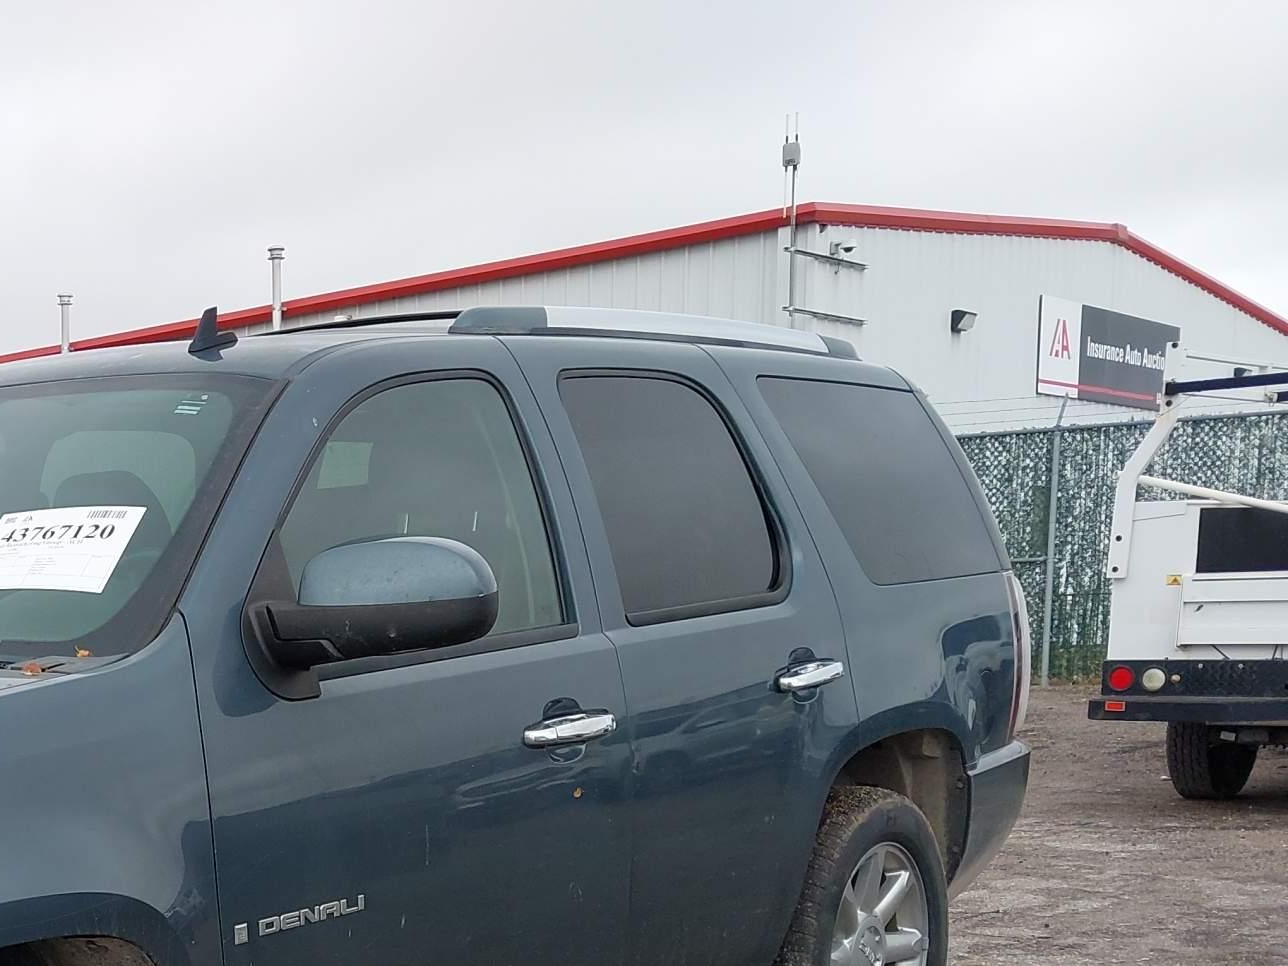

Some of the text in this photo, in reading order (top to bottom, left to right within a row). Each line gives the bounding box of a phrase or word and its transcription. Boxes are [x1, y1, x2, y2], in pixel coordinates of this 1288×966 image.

[1087, 336, 1165, 370] Insurance Auto Auctio
[1, 523, 116, 543] 43767120
[258, 894, 365, 936] DENALI
